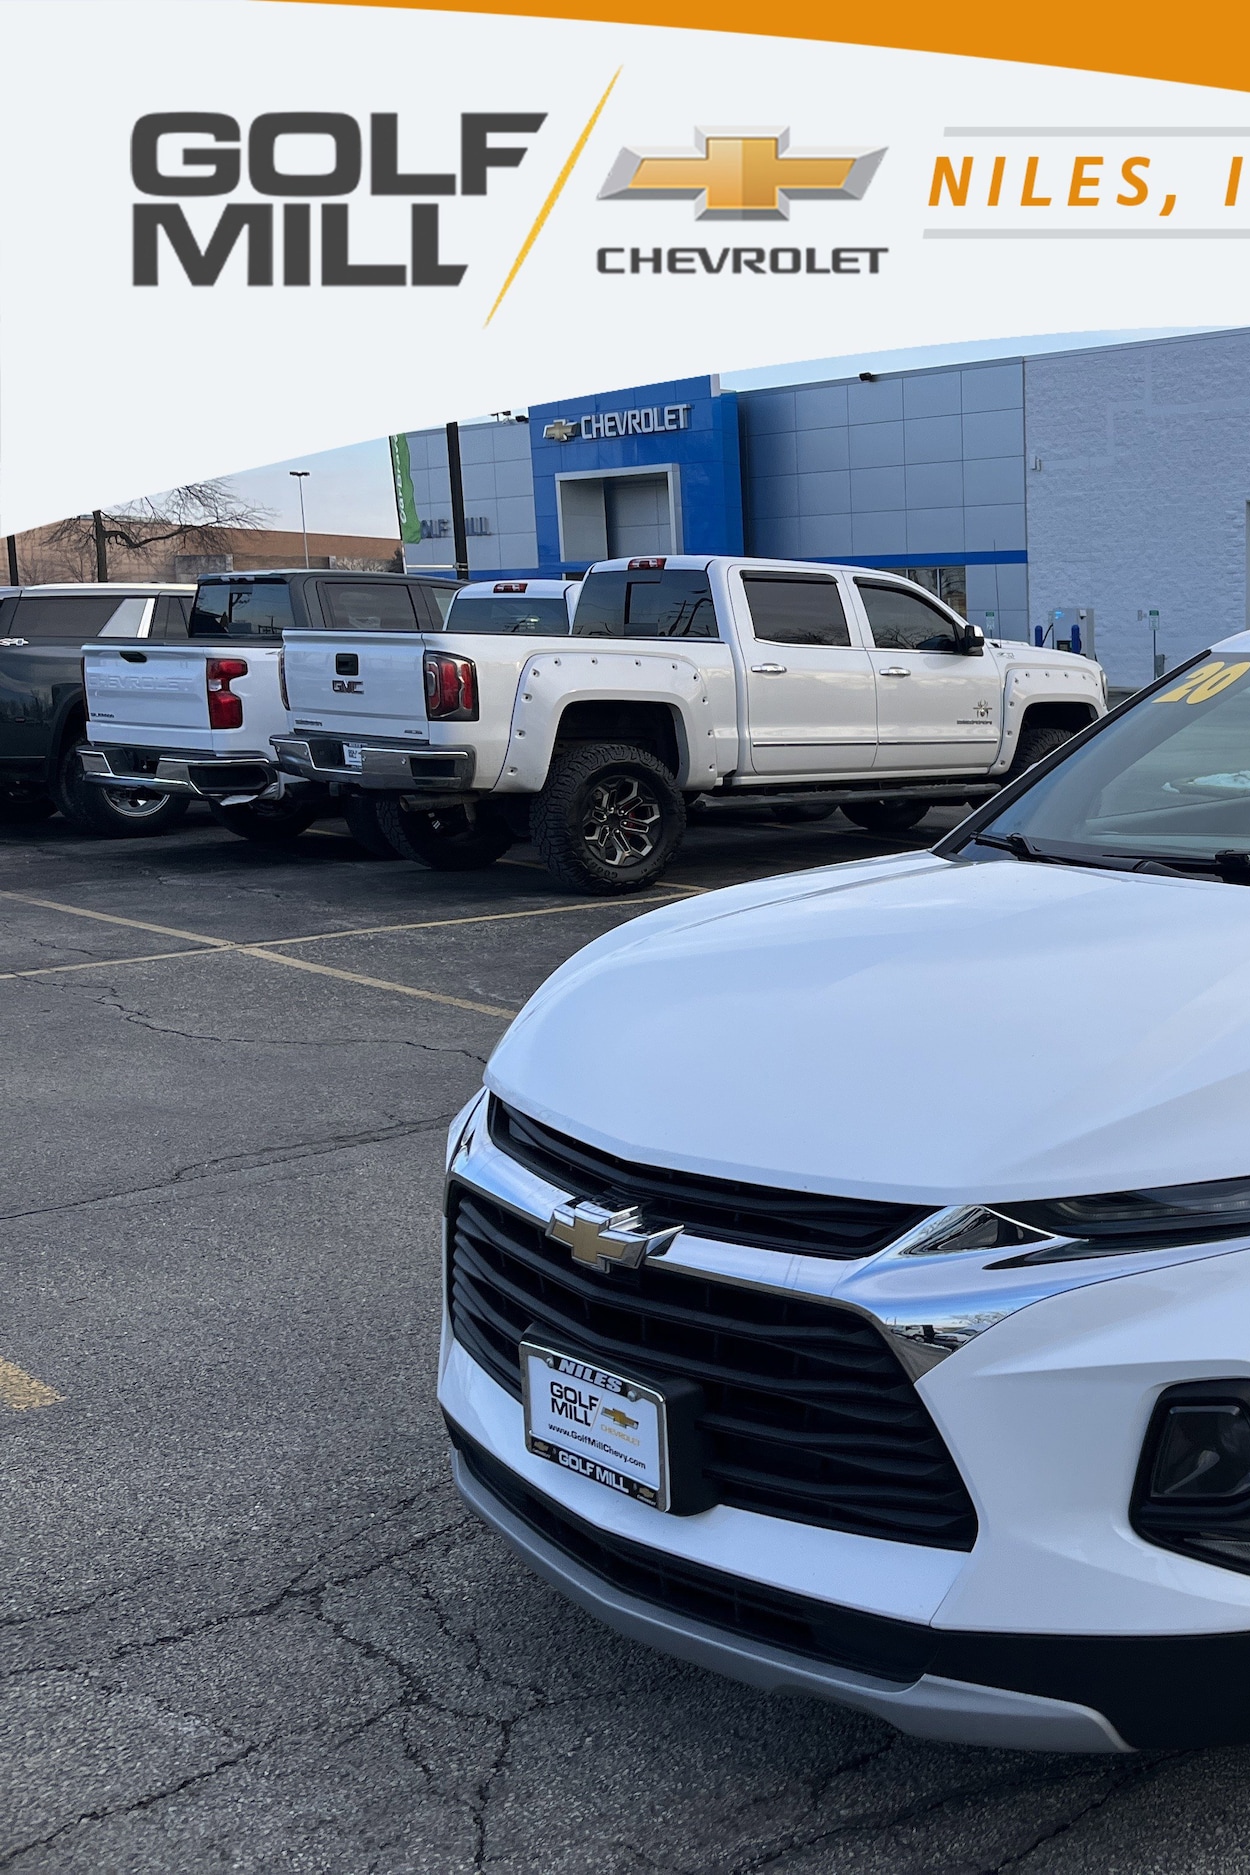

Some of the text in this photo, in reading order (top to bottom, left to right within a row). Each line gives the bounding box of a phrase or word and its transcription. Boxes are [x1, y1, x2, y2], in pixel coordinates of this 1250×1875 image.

[580, 404, 691, 440] CHEVROLET
[88, 674, 192, 691] CHEVROLET
[332, 680, 364, 694] GMC
[558, 1358, 623, 1394] NILES
[550, 1381, 599, 1411] GOLF
[551, 1396, 591, 1427] MILL
[548, 1422, 646, 1469] www.GolfMillChevy.com
[558, 1450, 629, 1494] GOLF MILL
